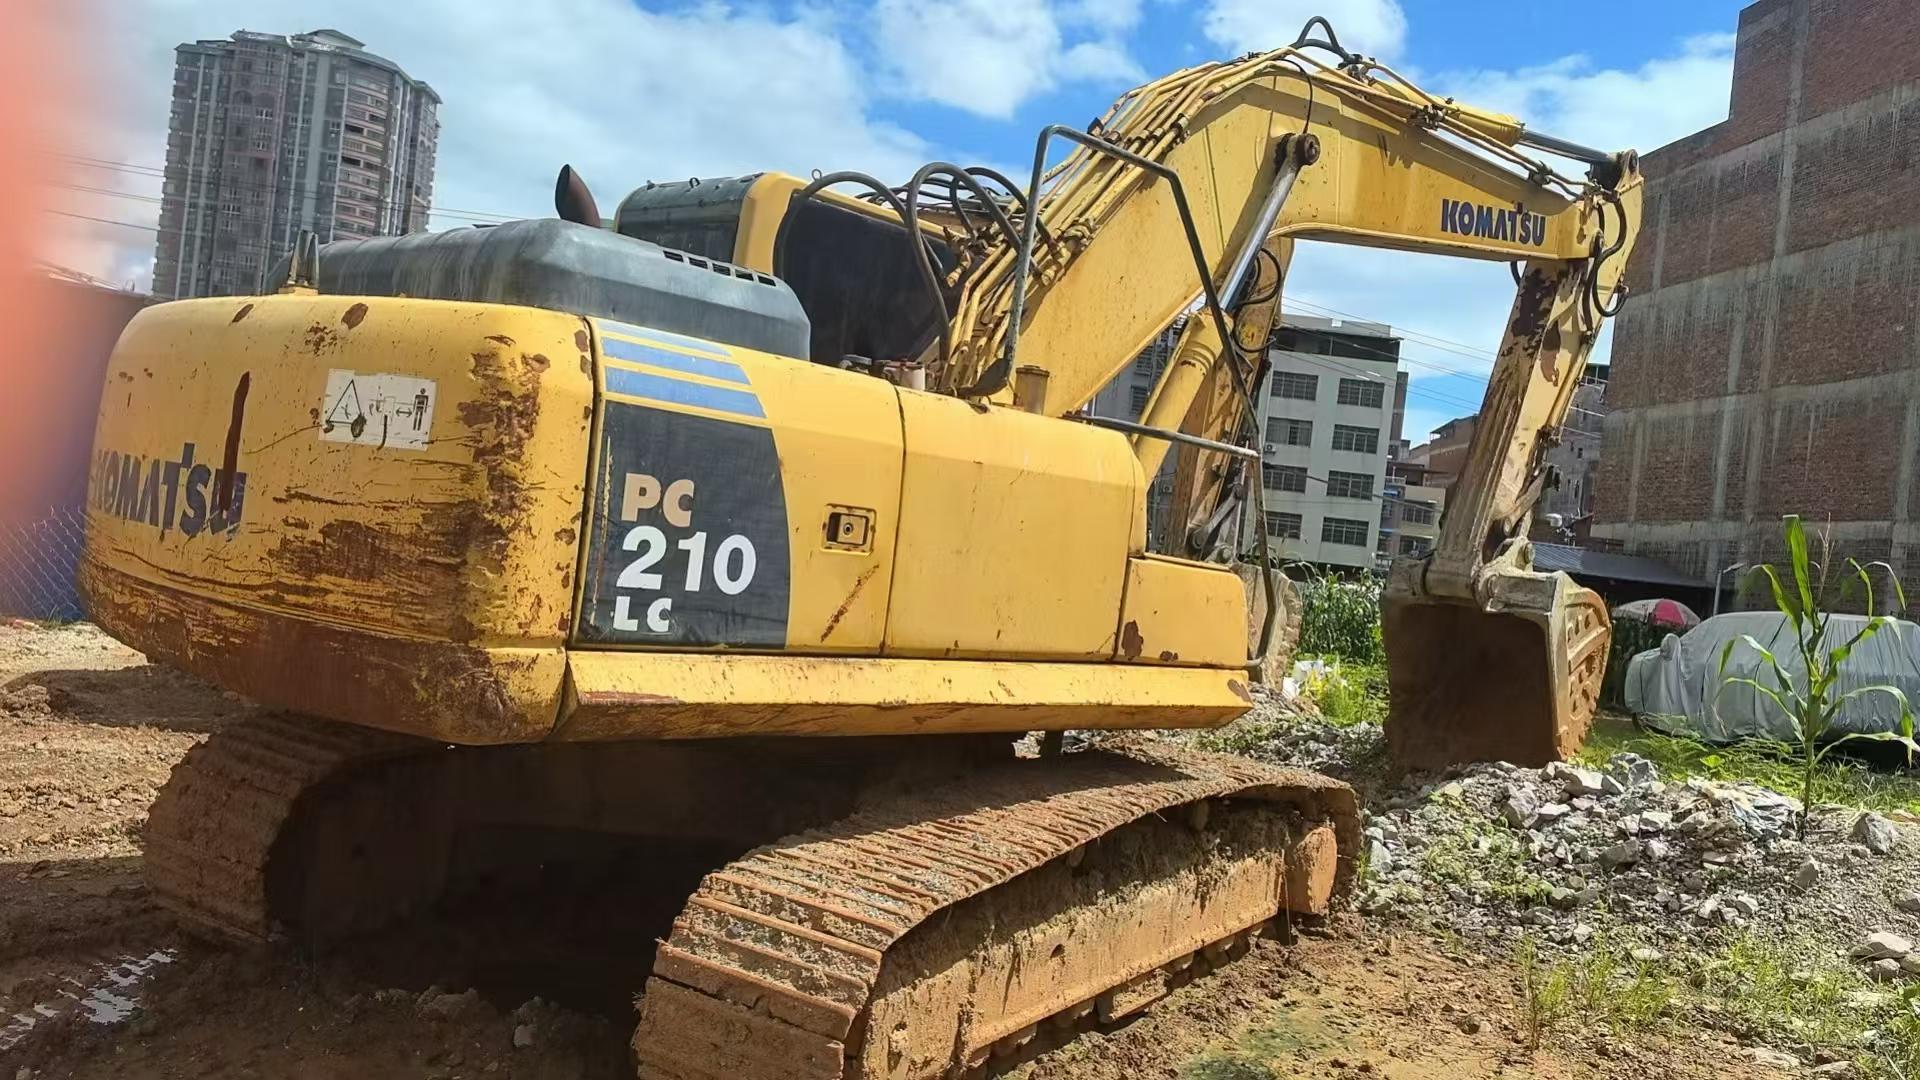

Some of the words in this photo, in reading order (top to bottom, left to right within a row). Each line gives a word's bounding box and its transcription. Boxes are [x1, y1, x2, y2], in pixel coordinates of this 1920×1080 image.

[1441, 199, 1546, 246] KOMATSU
[621, 472, 695, 528] PC
[616, 525, 757, 595] 210
[612, 596, 673, 632] LC
